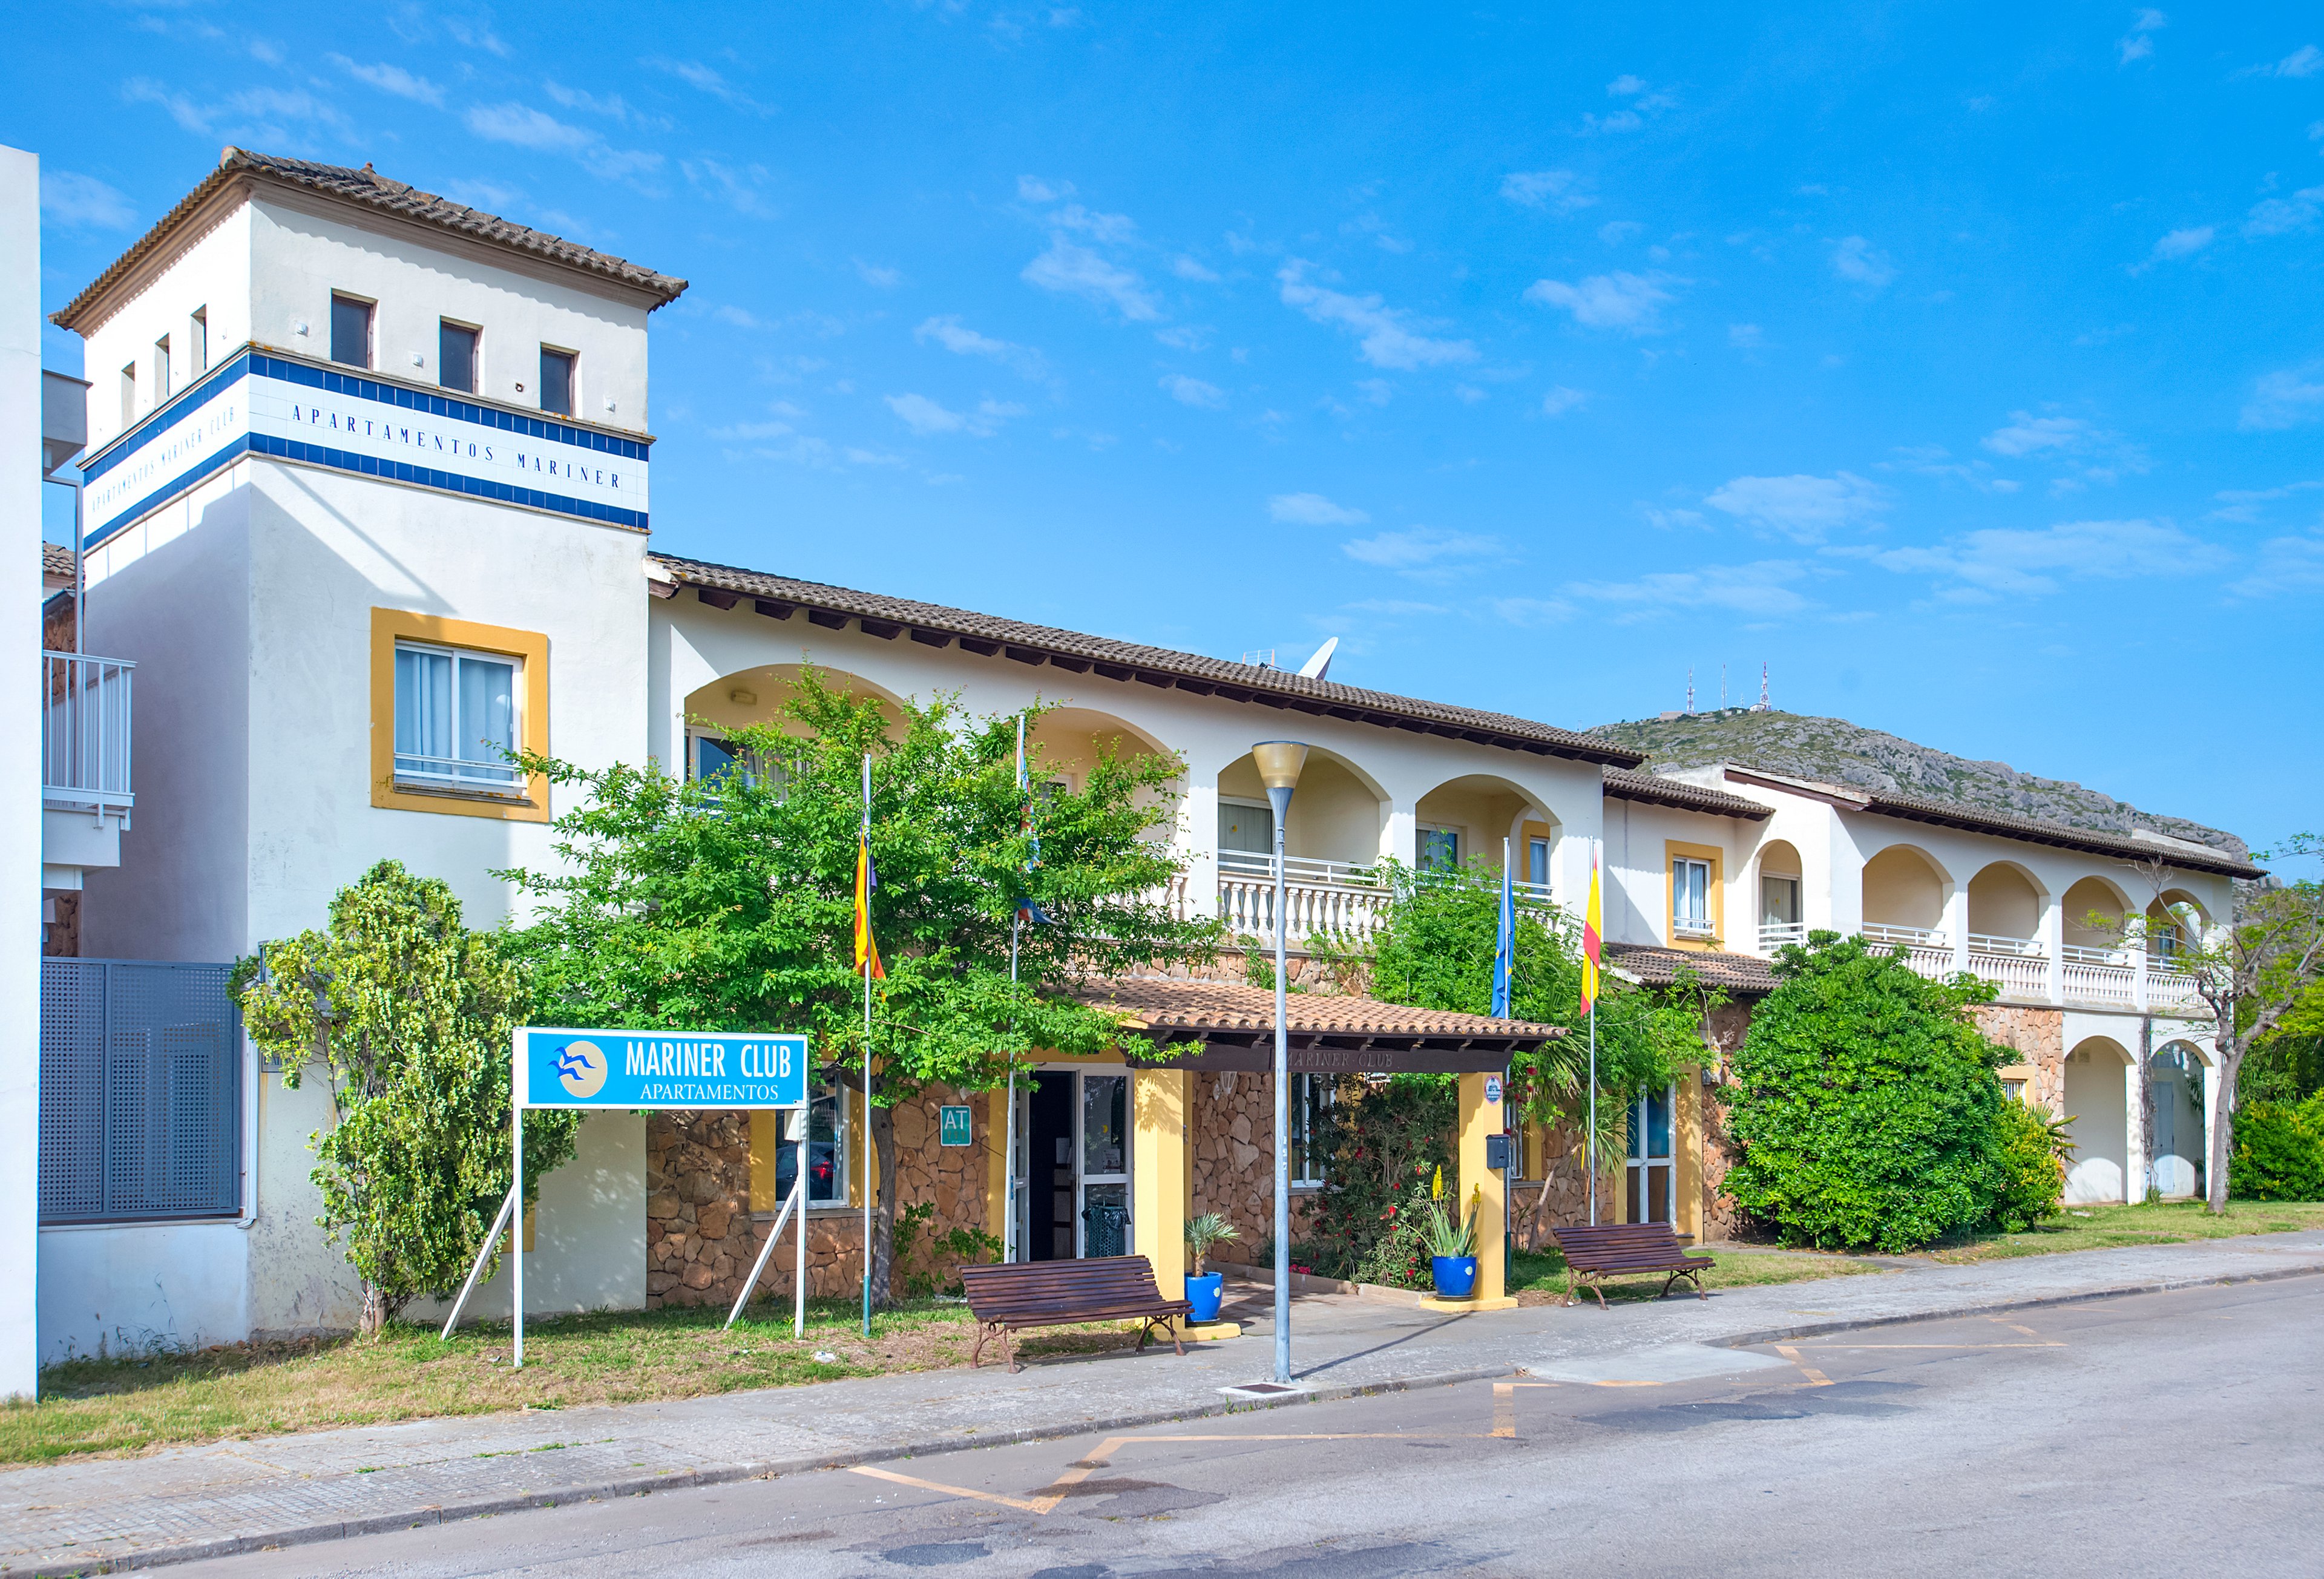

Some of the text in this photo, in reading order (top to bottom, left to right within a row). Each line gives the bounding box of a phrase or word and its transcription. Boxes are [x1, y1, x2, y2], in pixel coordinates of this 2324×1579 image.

[292, 404, 619, 489] APARTAMENTOS MARINER
[625, 1041, 791, 1078] MARINER CLUB
[1358, 1053, 1393, 1068] CLUB
[640, 1083, 779, 1100] APARTAMENTOS
[944, 1110, 968, 1130] AT
